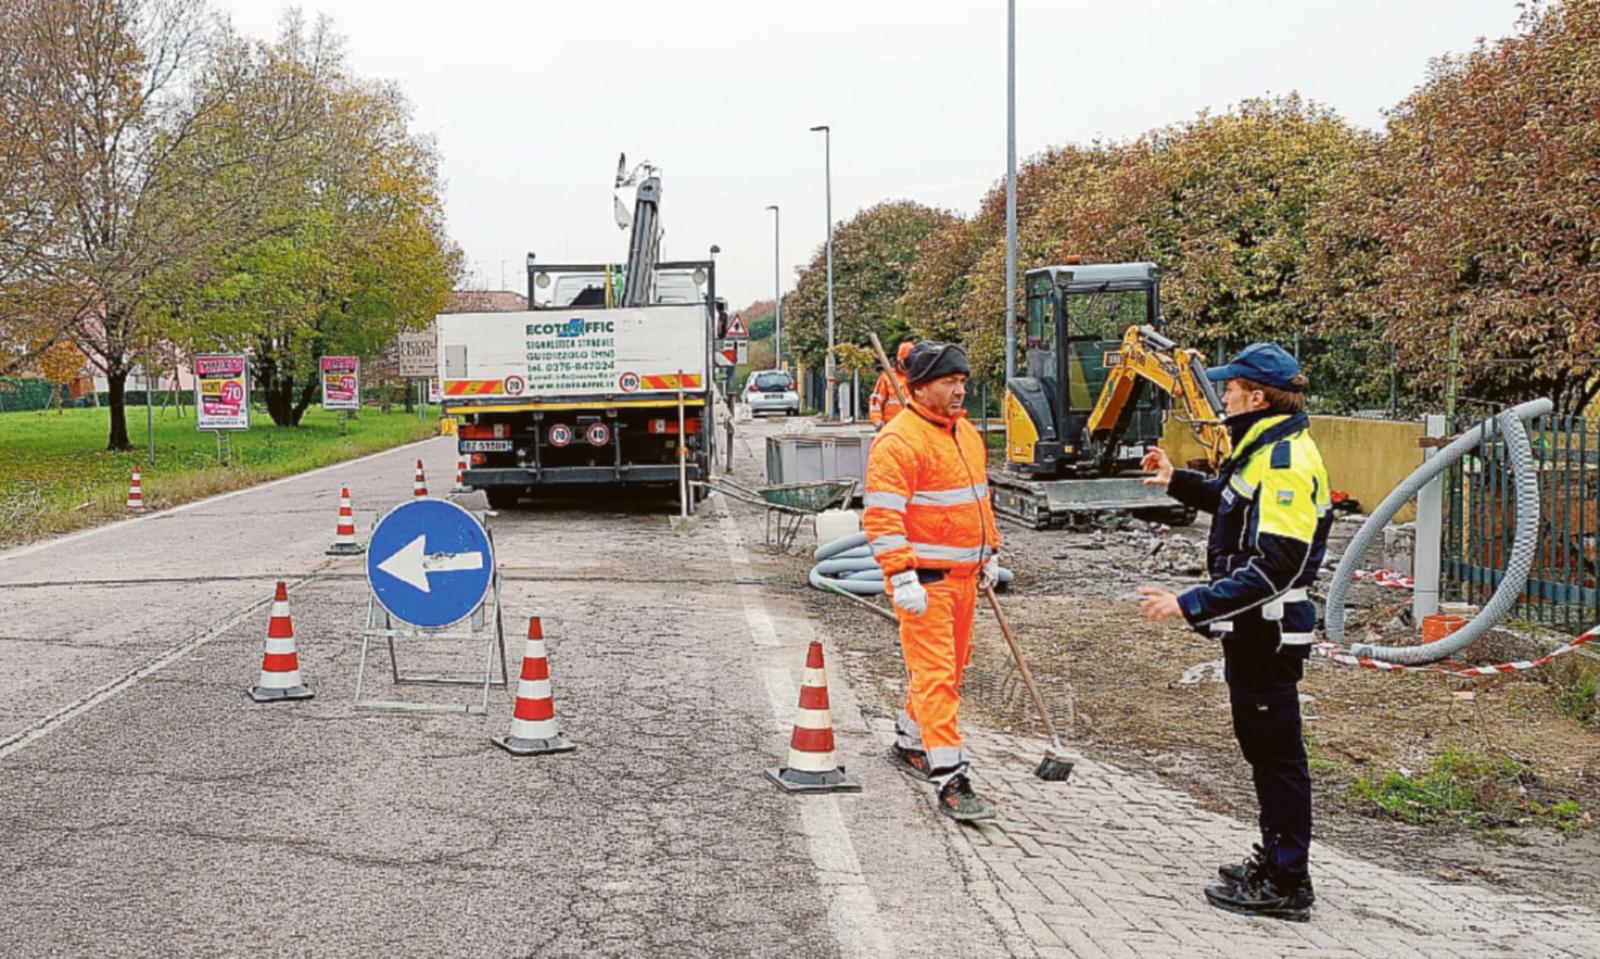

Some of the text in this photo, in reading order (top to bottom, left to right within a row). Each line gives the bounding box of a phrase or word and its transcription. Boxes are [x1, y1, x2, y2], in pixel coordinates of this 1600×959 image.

[526, 322, 615, 335] ECOTRAFFIC
[526, 349, 615, 361] GUIDIZZOLO (MN)
[509, 381, 520, 390] 70
[555, 430, 566, 440] 70
